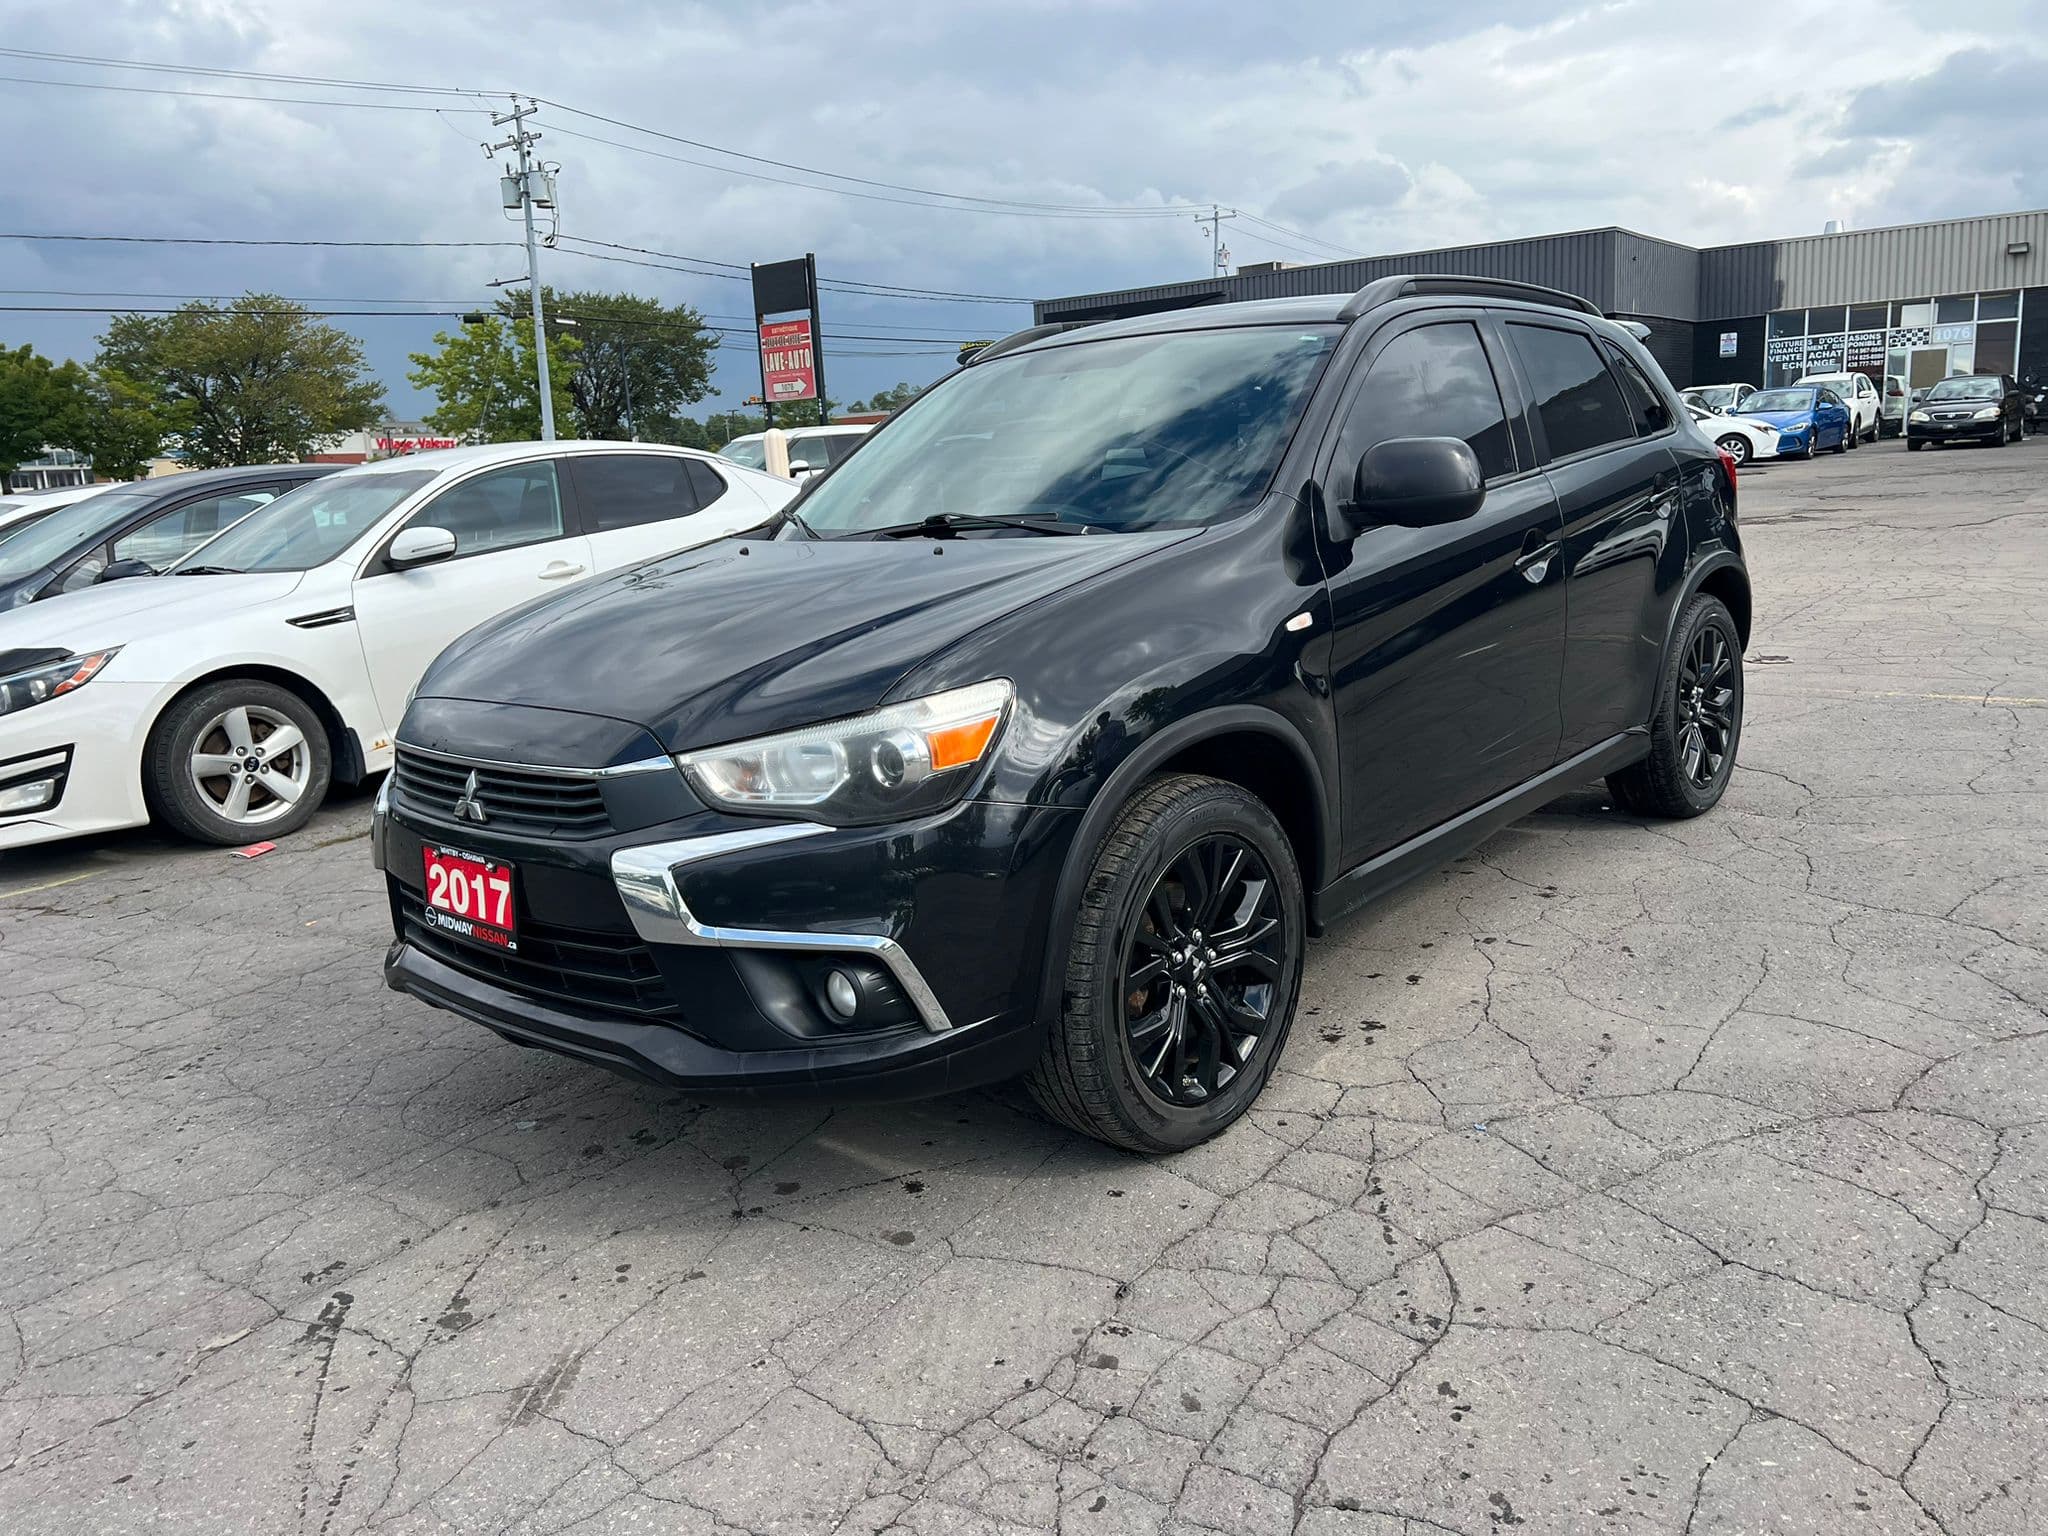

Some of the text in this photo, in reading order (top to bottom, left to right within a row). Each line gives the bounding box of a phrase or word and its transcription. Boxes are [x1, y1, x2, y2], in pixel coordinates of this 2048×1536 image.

[1769, 333, 1881, 349] VOITURES D'OCCASIONS
[1936, 327, 1970, 341] 1076
[1769, 339, 1882, 355] FINANCEMENT DISPONIBLE
[1768, 350, 1843, 362] VENTE ACHAT
[1782, 358, 1836, 370] ECHANGE
[376, 438, 413, 453] Vilage
[429, 863, 511, 925] 2017
